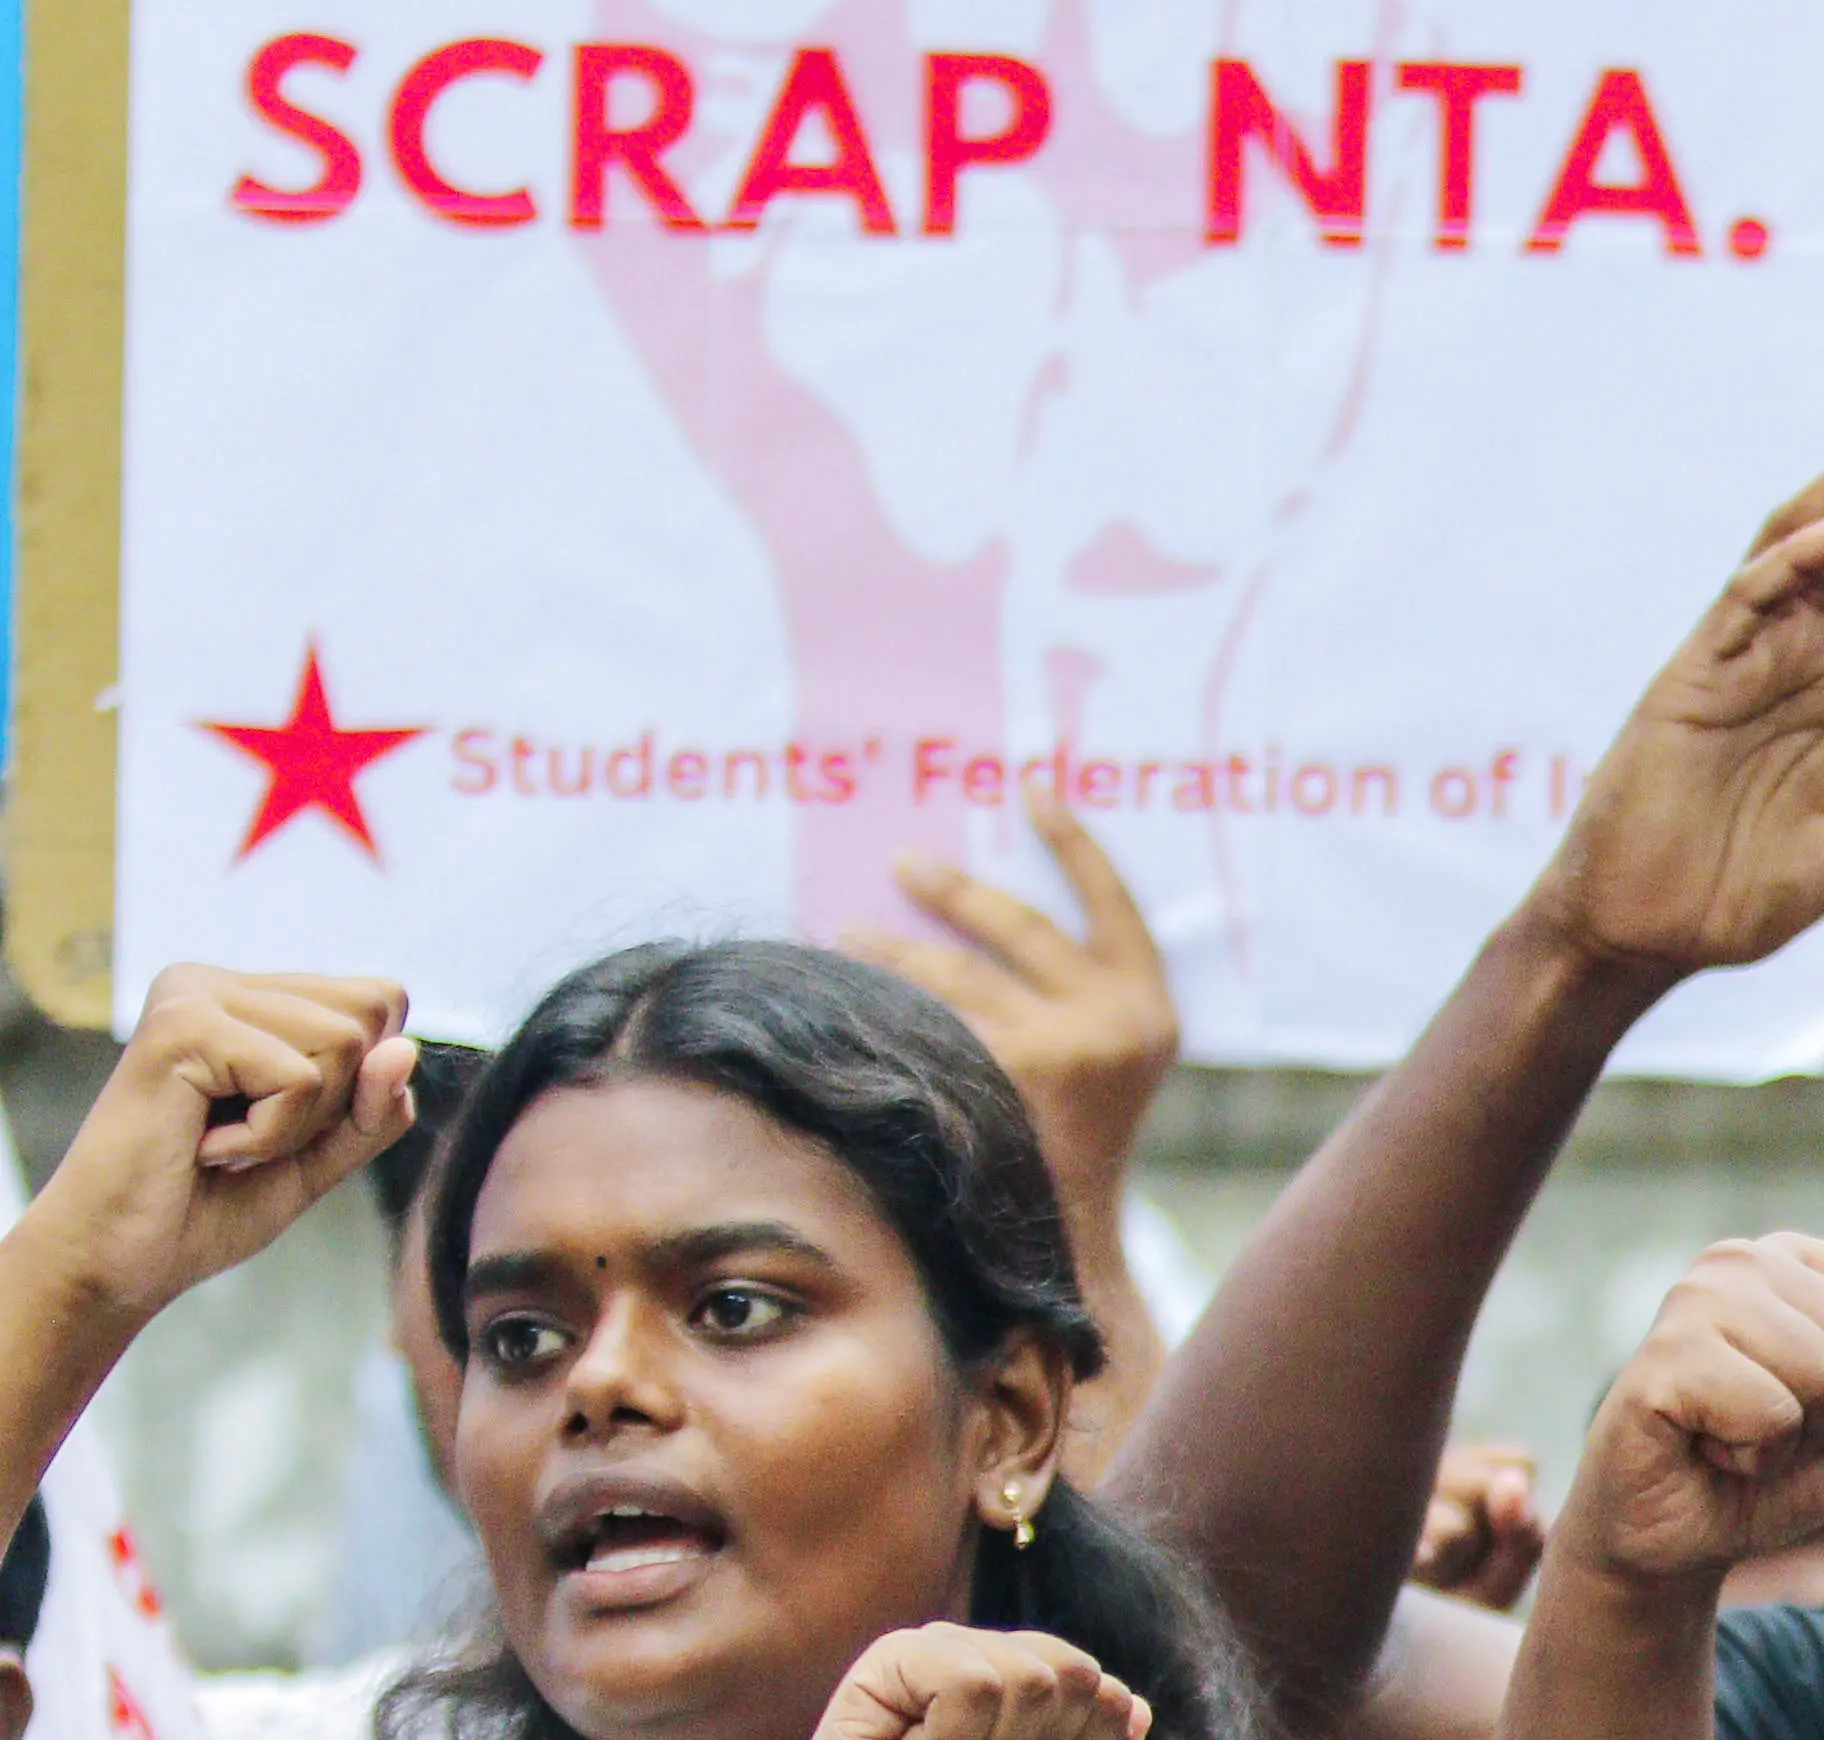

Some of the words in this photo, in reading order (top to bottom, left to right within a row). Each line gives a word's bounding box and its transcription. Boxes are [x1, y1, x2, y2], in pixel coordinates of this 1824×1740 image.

[232, 32, 1054, 238] SCRAP
[1204, 56, 1770, 261] NTA.
[448, 724, 884, 806] Students'
[910, 733, 1400, 818] Federation
[1428, 747, 1520, 822] of
